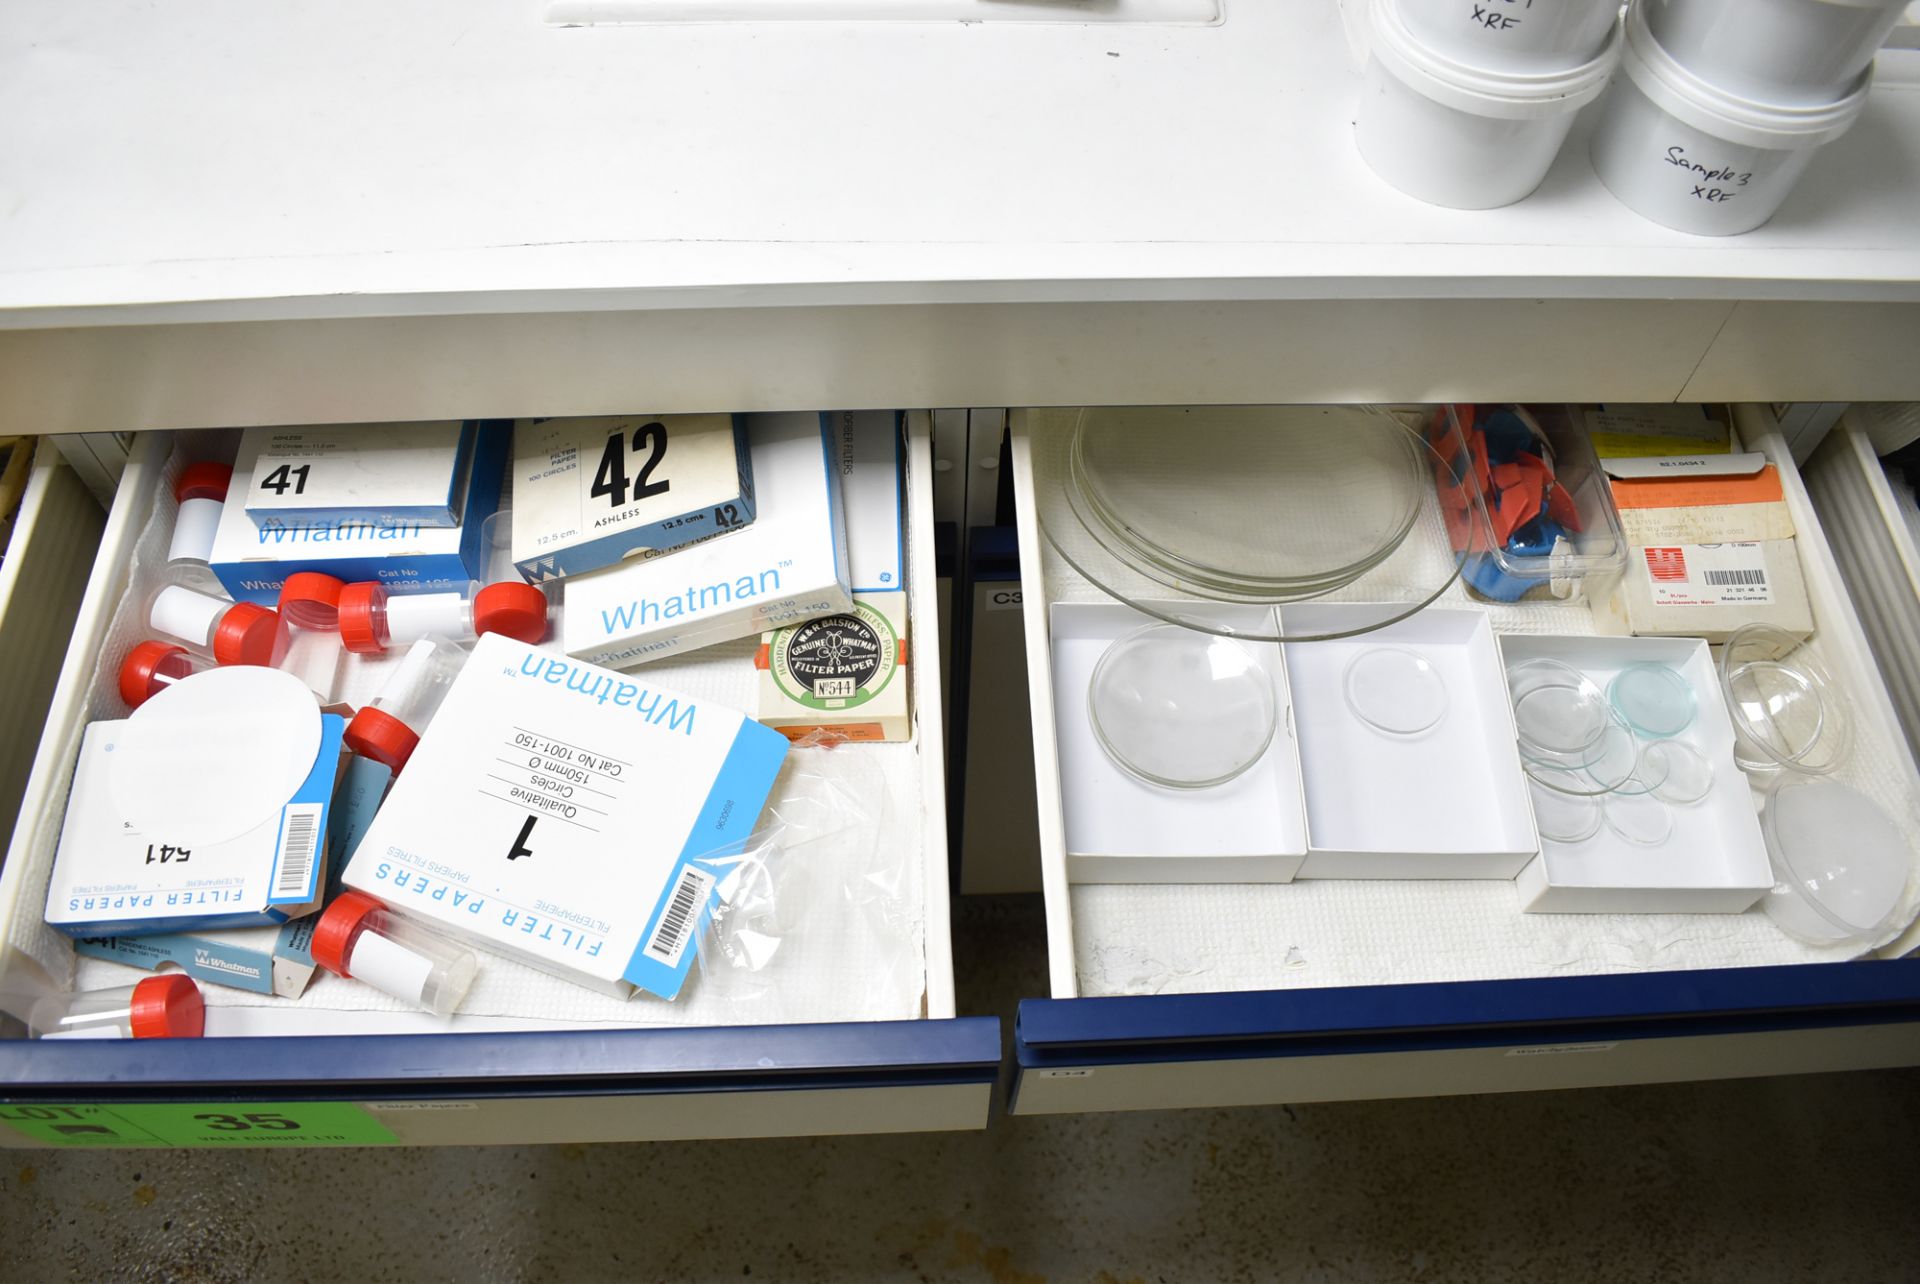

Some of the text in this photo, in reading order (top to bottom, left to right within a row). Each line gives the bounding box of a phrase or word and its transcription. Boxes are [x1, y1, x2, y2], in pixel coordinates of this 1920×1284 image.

[1471, 3, 1521, 30] XRF
[1664, 146, 1753, 187] Sample 3
[1690, 185, 1737, 203] XRF
[550, 447, 577, 460] FILTER
[551, 454, 577, 466] PAPER
[590, 421, 670, 508] 42
[260, 463, 312, 495] 41
[528, 463, 577, 482] 100 CIRCLES
[594, 508, 641, 528] ASHLESS
[662, 518, 684, 531] 12.5
[714, 504, 744, 528] 42
[536, 532, 562, 546] 12.5
[378, 568, 419, 578] Cat No
[822, 618, 861, 633] BALSTON
[776, 626, 795, 676] HARDENED
[791, 637, 877, 656] GENUINE WHATMAN
[881, 639, 892, 671] PAPER
[794, 658, 875, 675] FILTER PAPER
[514, 732, 623, 777] Cat No 1001-150
[544, 759, 590, 786] 150mm
[530, 775, 574, 799] Circles
[510, 786, 578, 820] Qualitative
[507, 814, 538, 861] 1
[145, 844, 192, 865] 541
[68, 889, 243, 912] FILTER PAPERS
[386, 845, 611, 934] FILTERPAPIERE PAPIERS FILTRES
[374, 862, 605, 957] FILTER PAPERS
[210, 958, 260, 975] Whatman
[193, 1113, 301, 1131] 35
